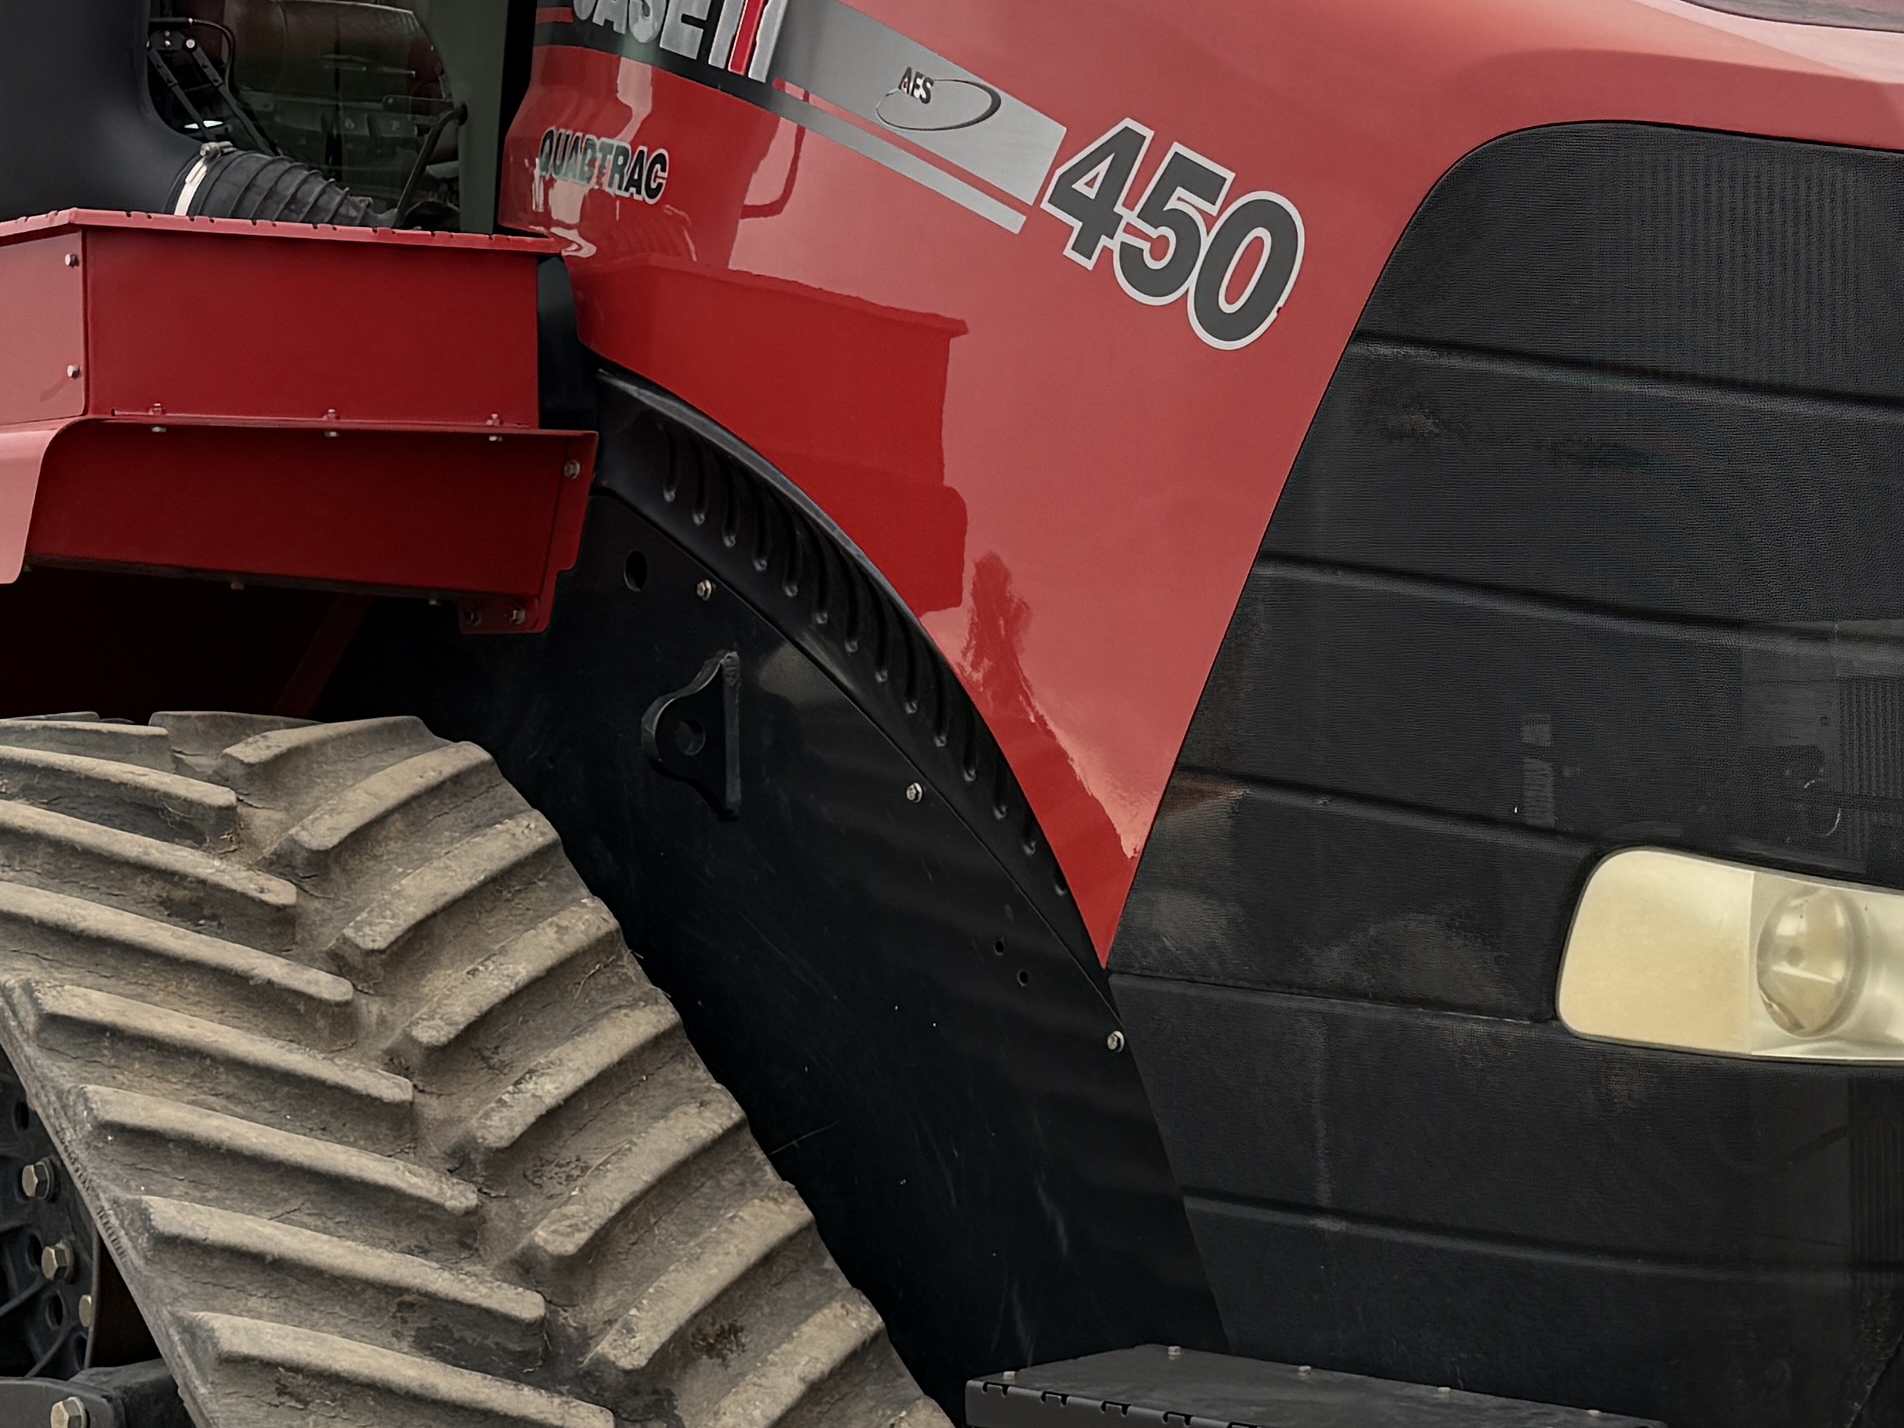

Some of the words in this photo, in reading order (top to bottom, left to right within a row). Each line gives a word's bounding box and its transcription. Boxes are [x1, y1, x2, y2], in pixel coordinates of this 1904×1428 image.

[898, 67, 934, 104] AES
[539, 126, 669, 204] QUADTRAC
[1040, 117, 1305, 350] 450
